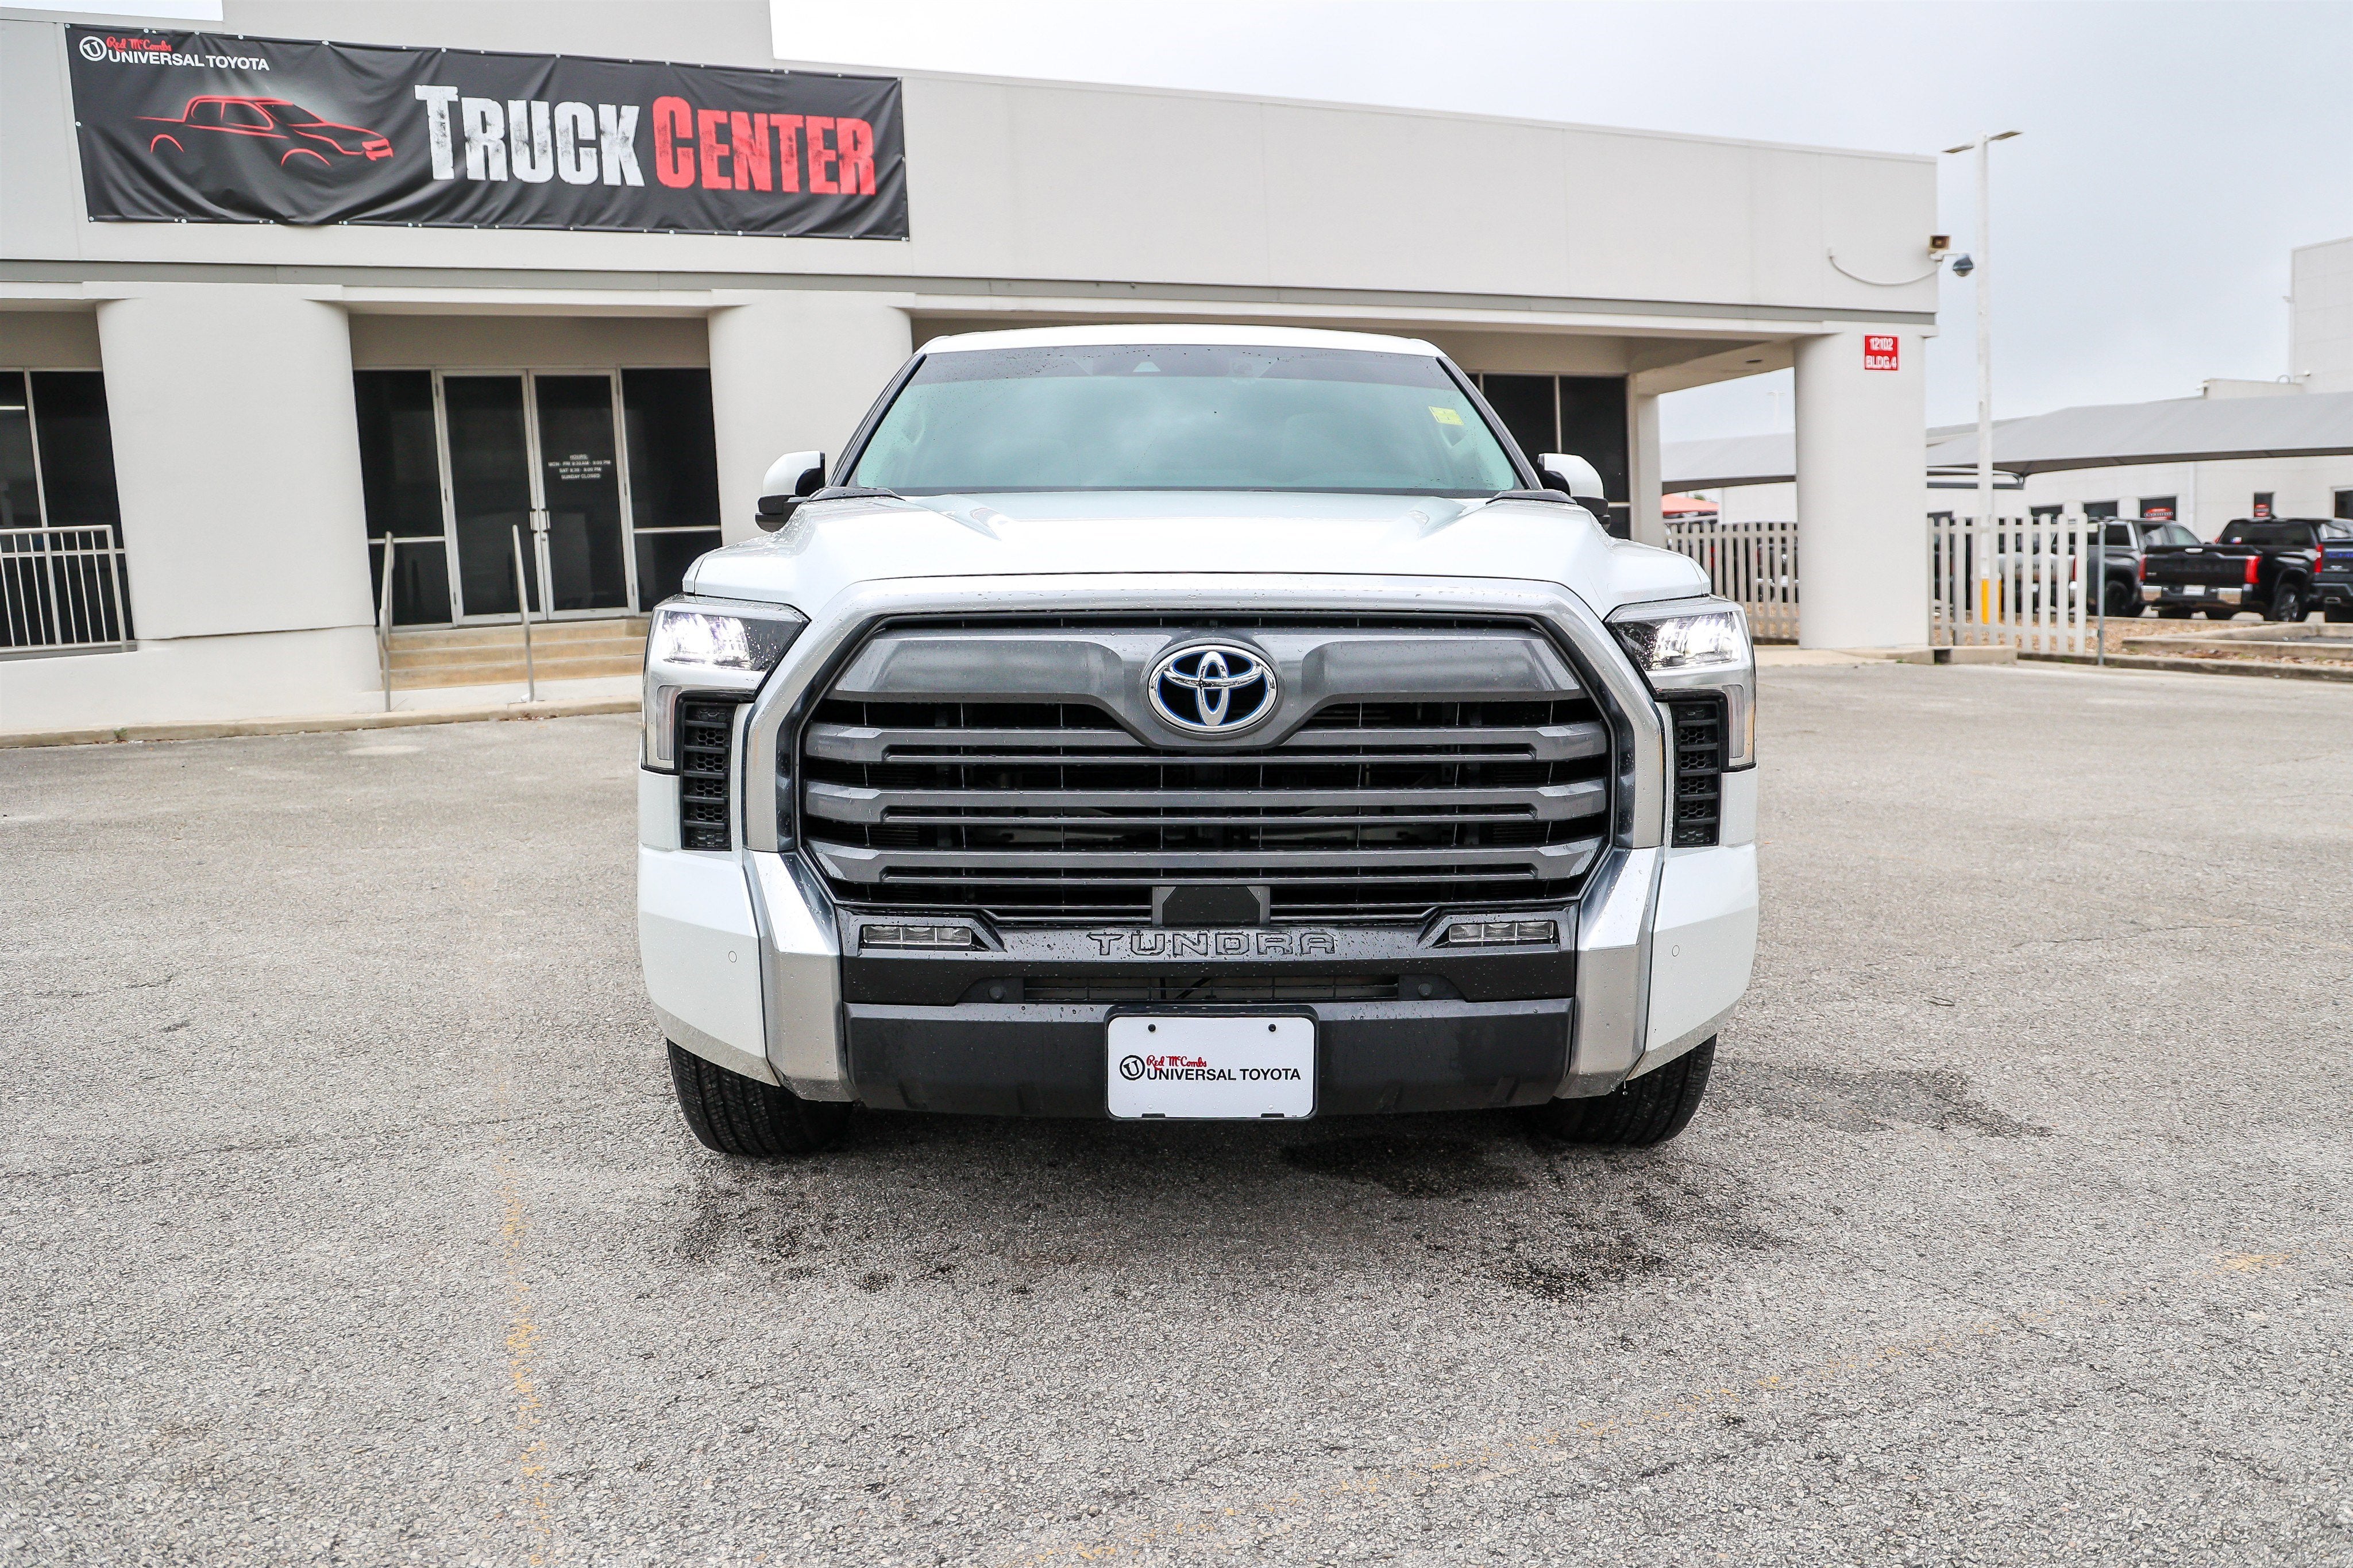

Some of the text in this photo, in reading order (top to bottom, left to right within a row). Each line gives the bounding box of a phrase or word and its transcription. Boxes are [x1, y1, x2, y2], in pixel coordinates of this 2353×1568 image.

[106, 36, 172, 53] Red McCombs
[107, 49, 270, 71] UNIVERSAL TOYOTA
[414, 84, 876, 195] TRUCK CENTER
[1869, 337, 1893, 351] 12102
[1086, 932, 1336, 956] TUNDRA
[1146, 1055, 1207, 1071] Red McCombs
[1147, 1068, 1301, 1081] UNIVERSAL TOYOTA
